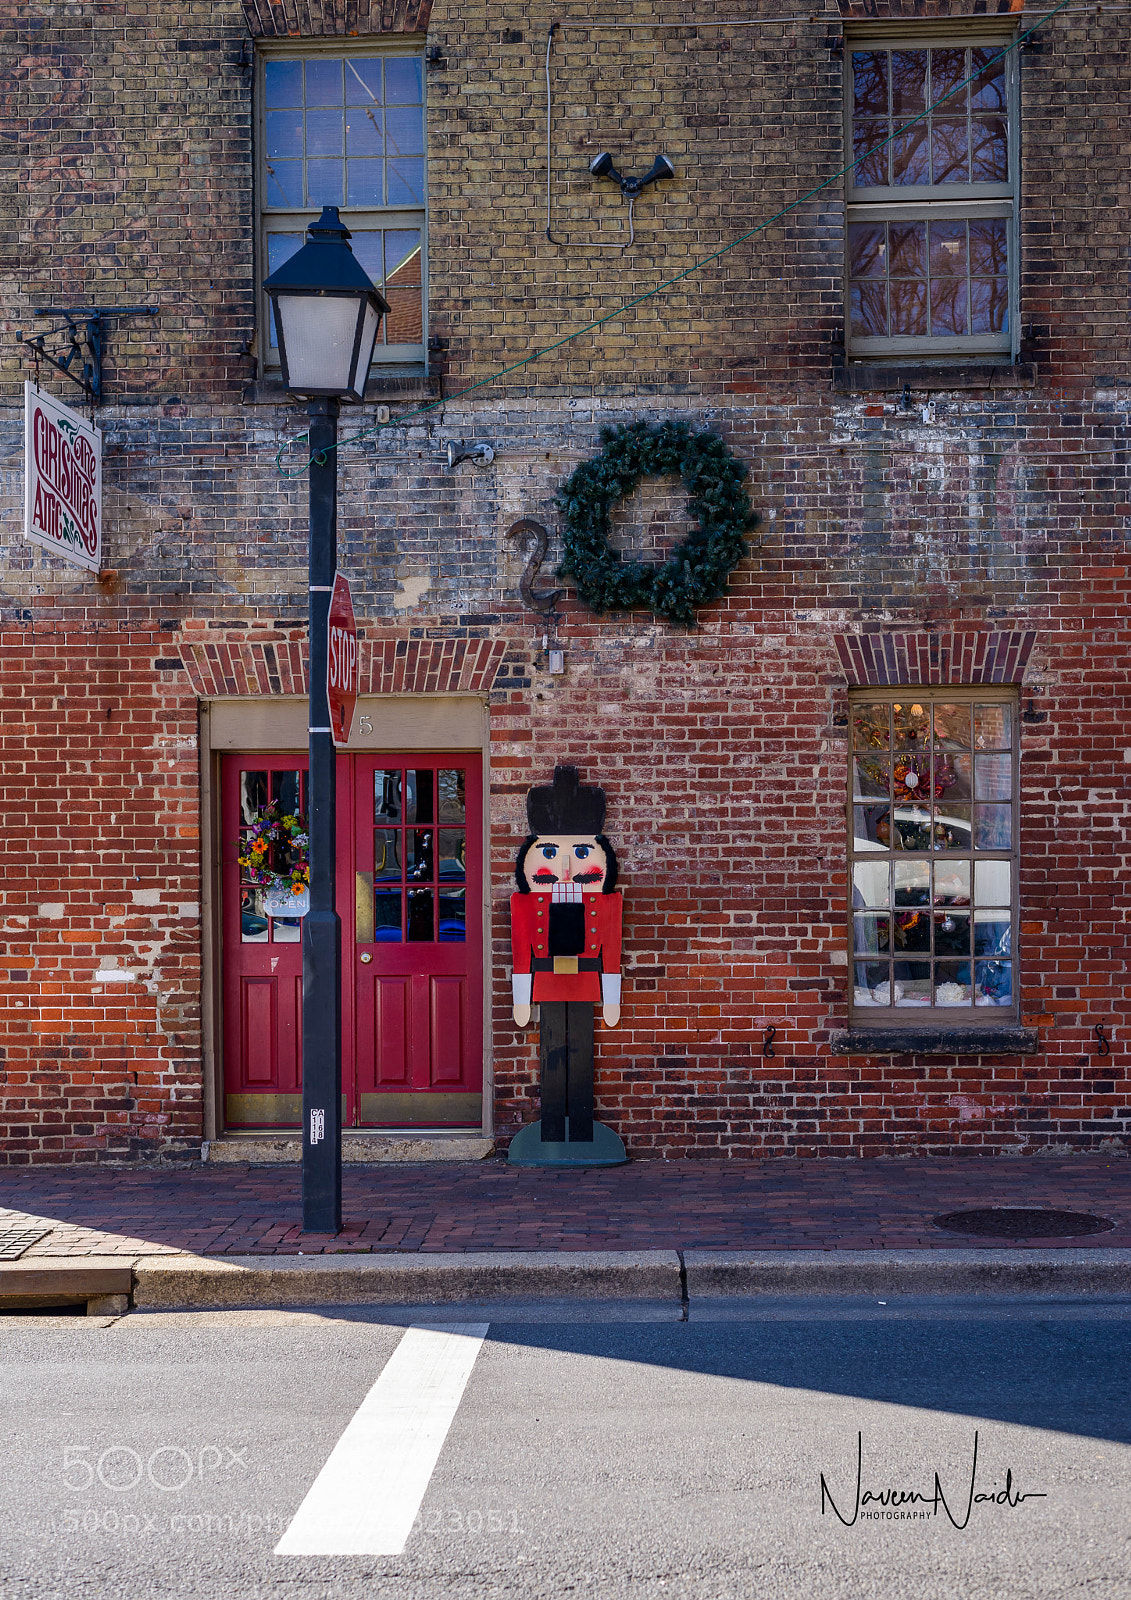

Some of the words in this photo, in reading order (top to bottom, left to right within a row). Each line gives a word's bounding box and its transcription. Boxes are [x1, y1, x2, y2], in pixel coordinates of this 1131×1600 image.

[74, 435, 96, 486] The
[330, 625, 356, 691] STOP
[359, 716, 374, 736] 5
[269, 900, 306, 908] OPEN
